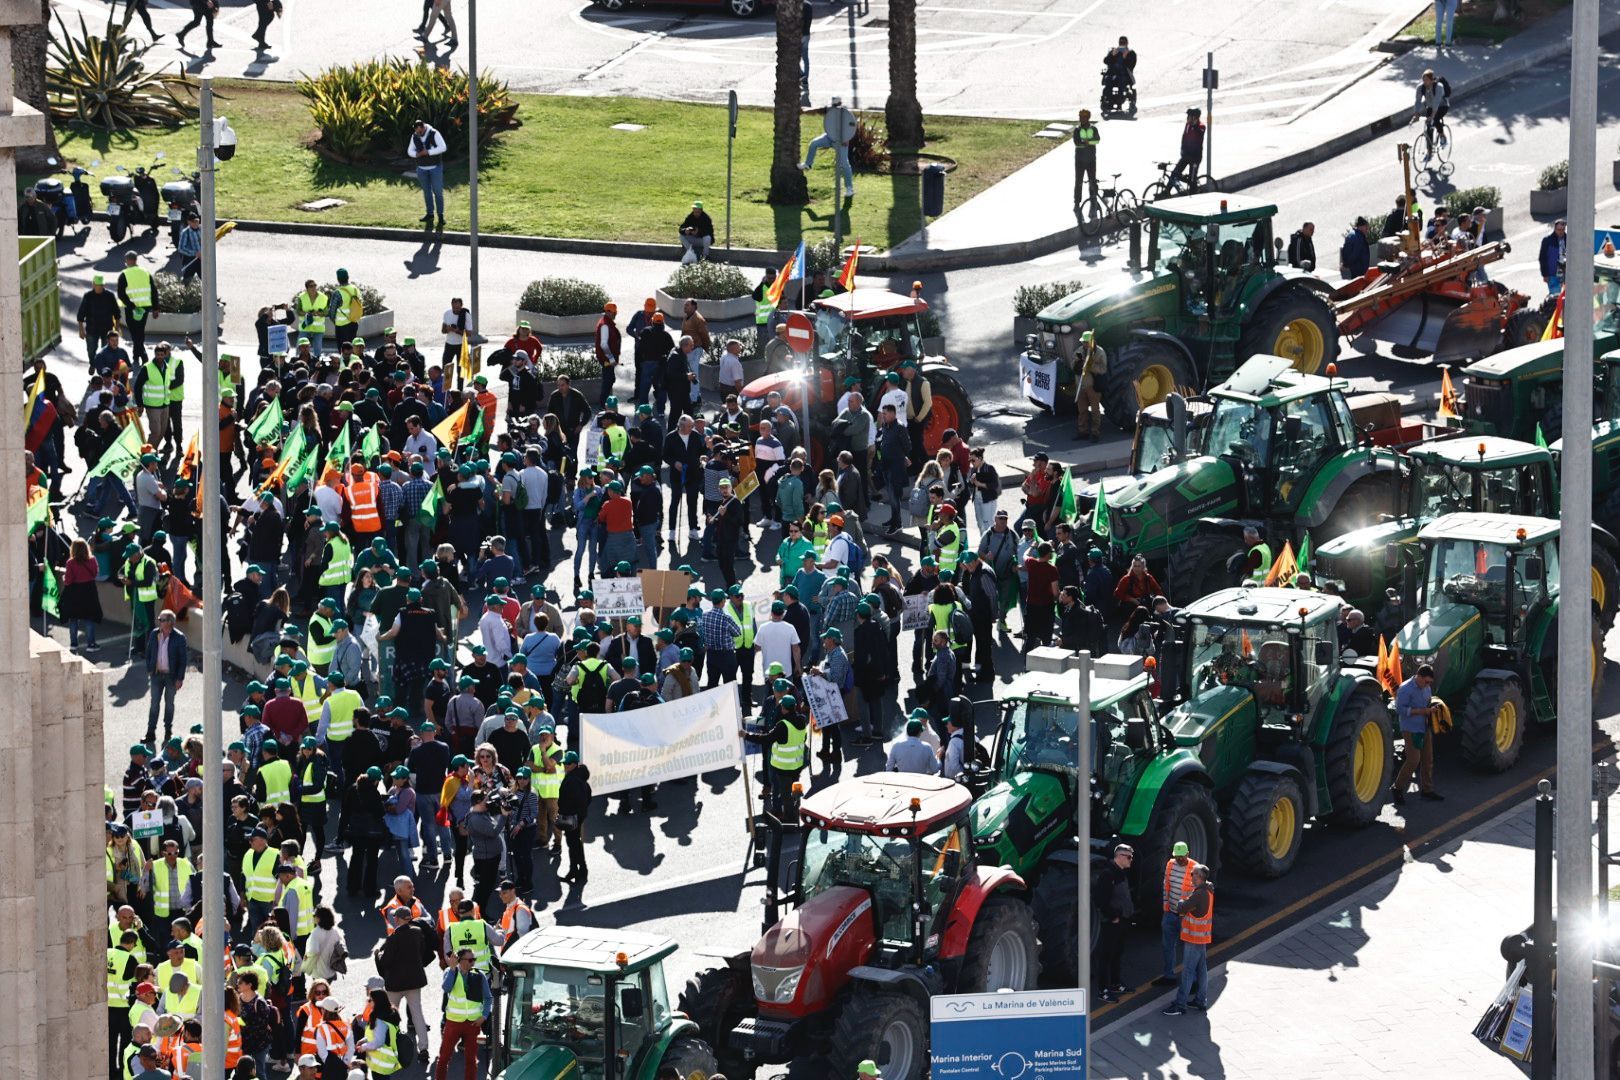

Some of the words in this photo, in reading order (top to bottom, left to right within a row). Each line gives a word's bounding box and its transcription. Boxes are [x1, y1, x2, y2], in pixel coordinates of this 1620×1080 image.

[982, 1002, 993, 1010] La
[995, 1000, 1024, 1009] Marina
[1026, 1000, 1037, 1008] de
[1039, 998, 1075, 1007] València
[931, 1055, 960, 1063] Marina
[962, 1053, 993, 1062] Interior
[1034, 1050, 1064, 1058] Marina
[1066, 1048, 1082, 1057] Sud
